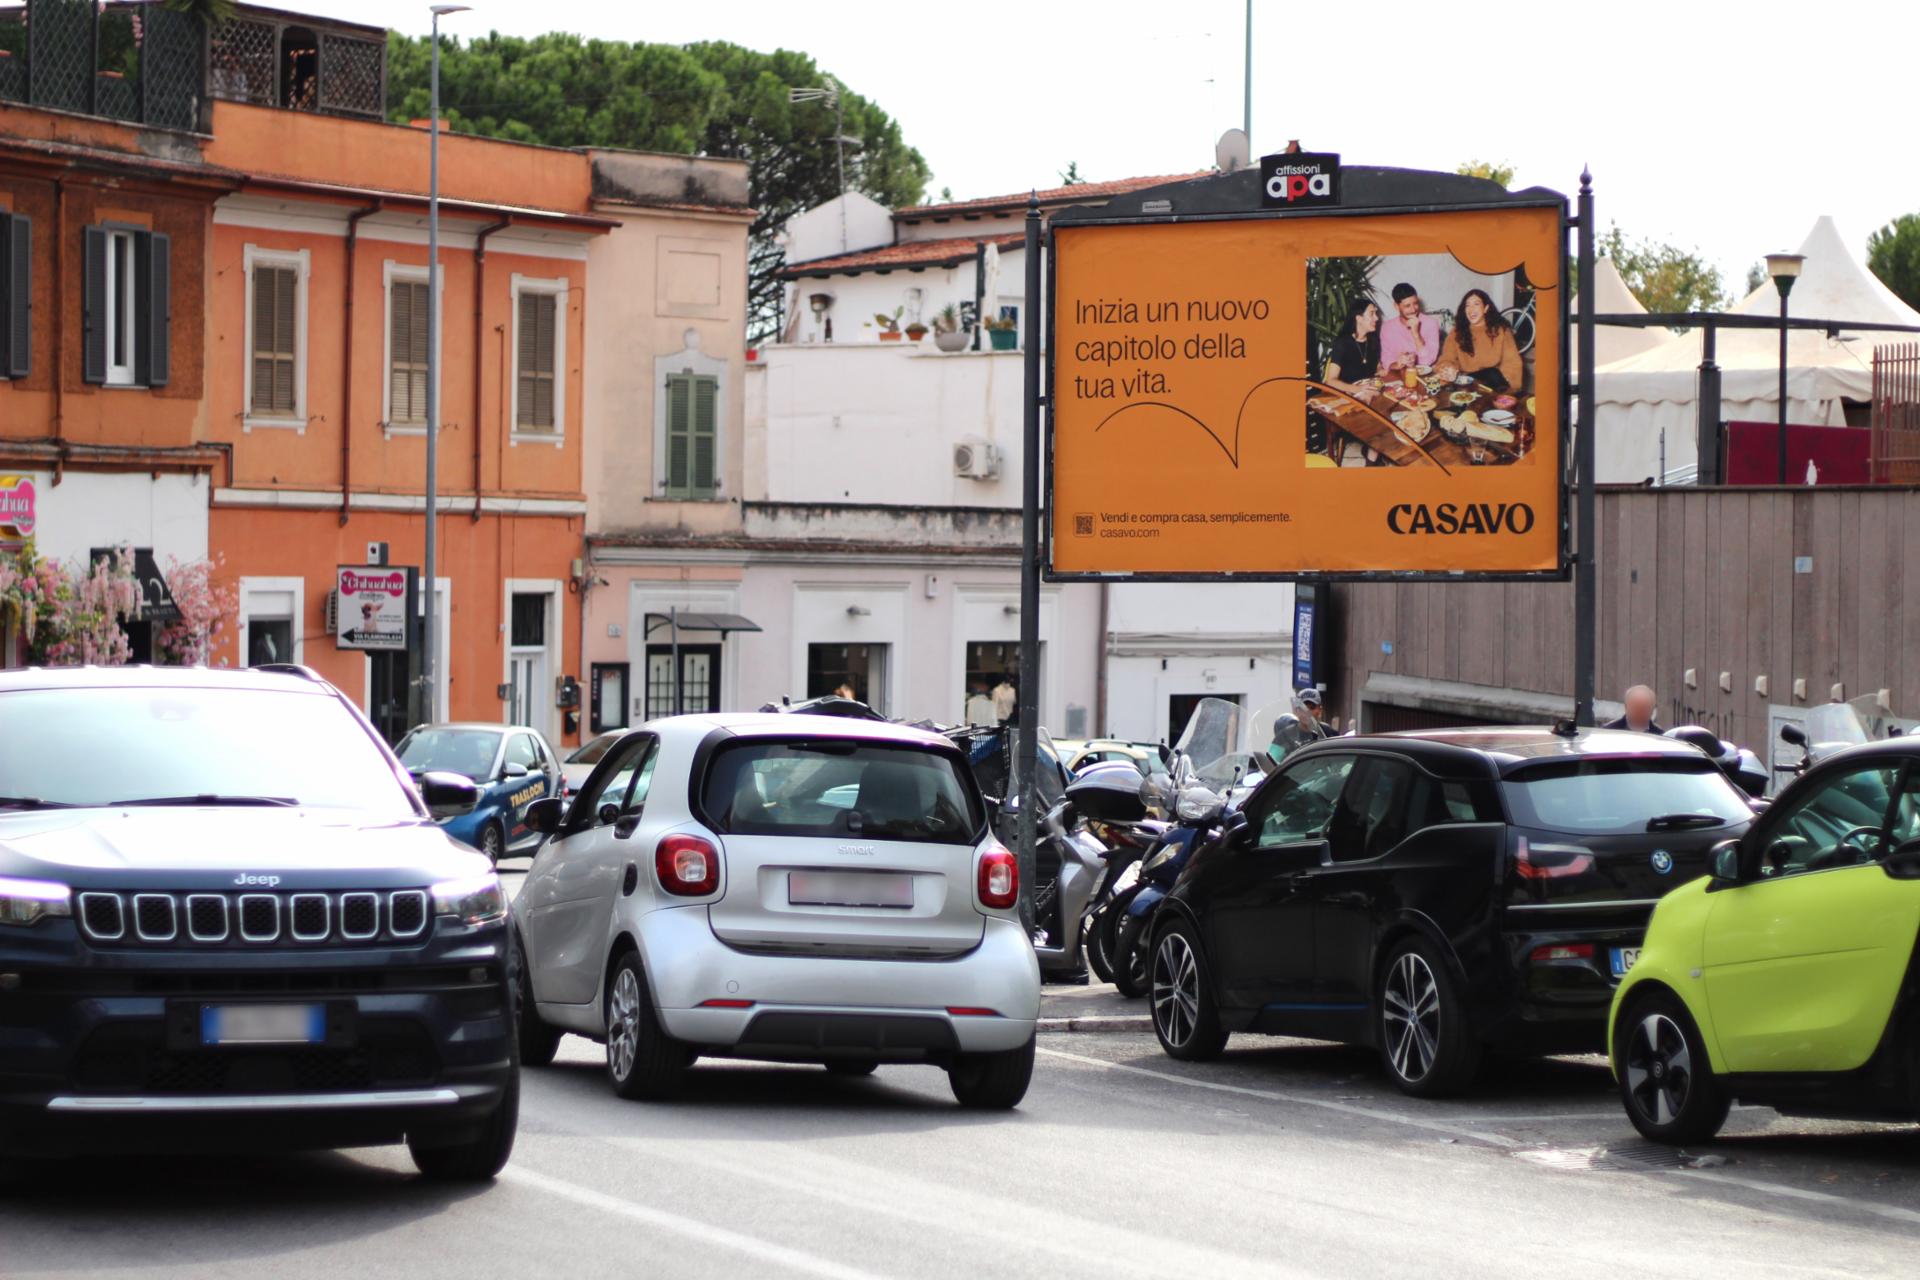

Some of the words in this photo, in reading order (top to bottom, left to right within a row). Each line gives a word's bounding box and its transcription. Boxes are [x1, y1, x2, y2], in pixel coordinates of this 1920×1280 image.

[1275, 164, 1320, 175] affissioni
[1266, 174, 1330, 202] apa
[1076, 298, 1139, 324] Inizia
[1146, 300, 1179, 323] un
[1187, 300, 1269, 321] nuovo
[1075, 335, 1176, 367] capitolo
[1183, 333, 1246, 359] della
[1074, 375, 1115, 399] tua
[1121, 368, 1171, 398] vita.
[1100, 512, 1130, 523] Vendi
[1131, 515, 1137, 523] e
[1139, 514, 1179, 525] compra
[1181, 514, 1208, 524] casa,
[1210, 512, 1291, 524] semplicemente.
[1387, 503, 1535, 534] CASAVO
[1100, 528, 1160, 538] casavo.com
[511, 781, 545, 808] TRASLOCHI
[838, 845, 875, 856] smart
[234, 873, 280, 887] Jeep
